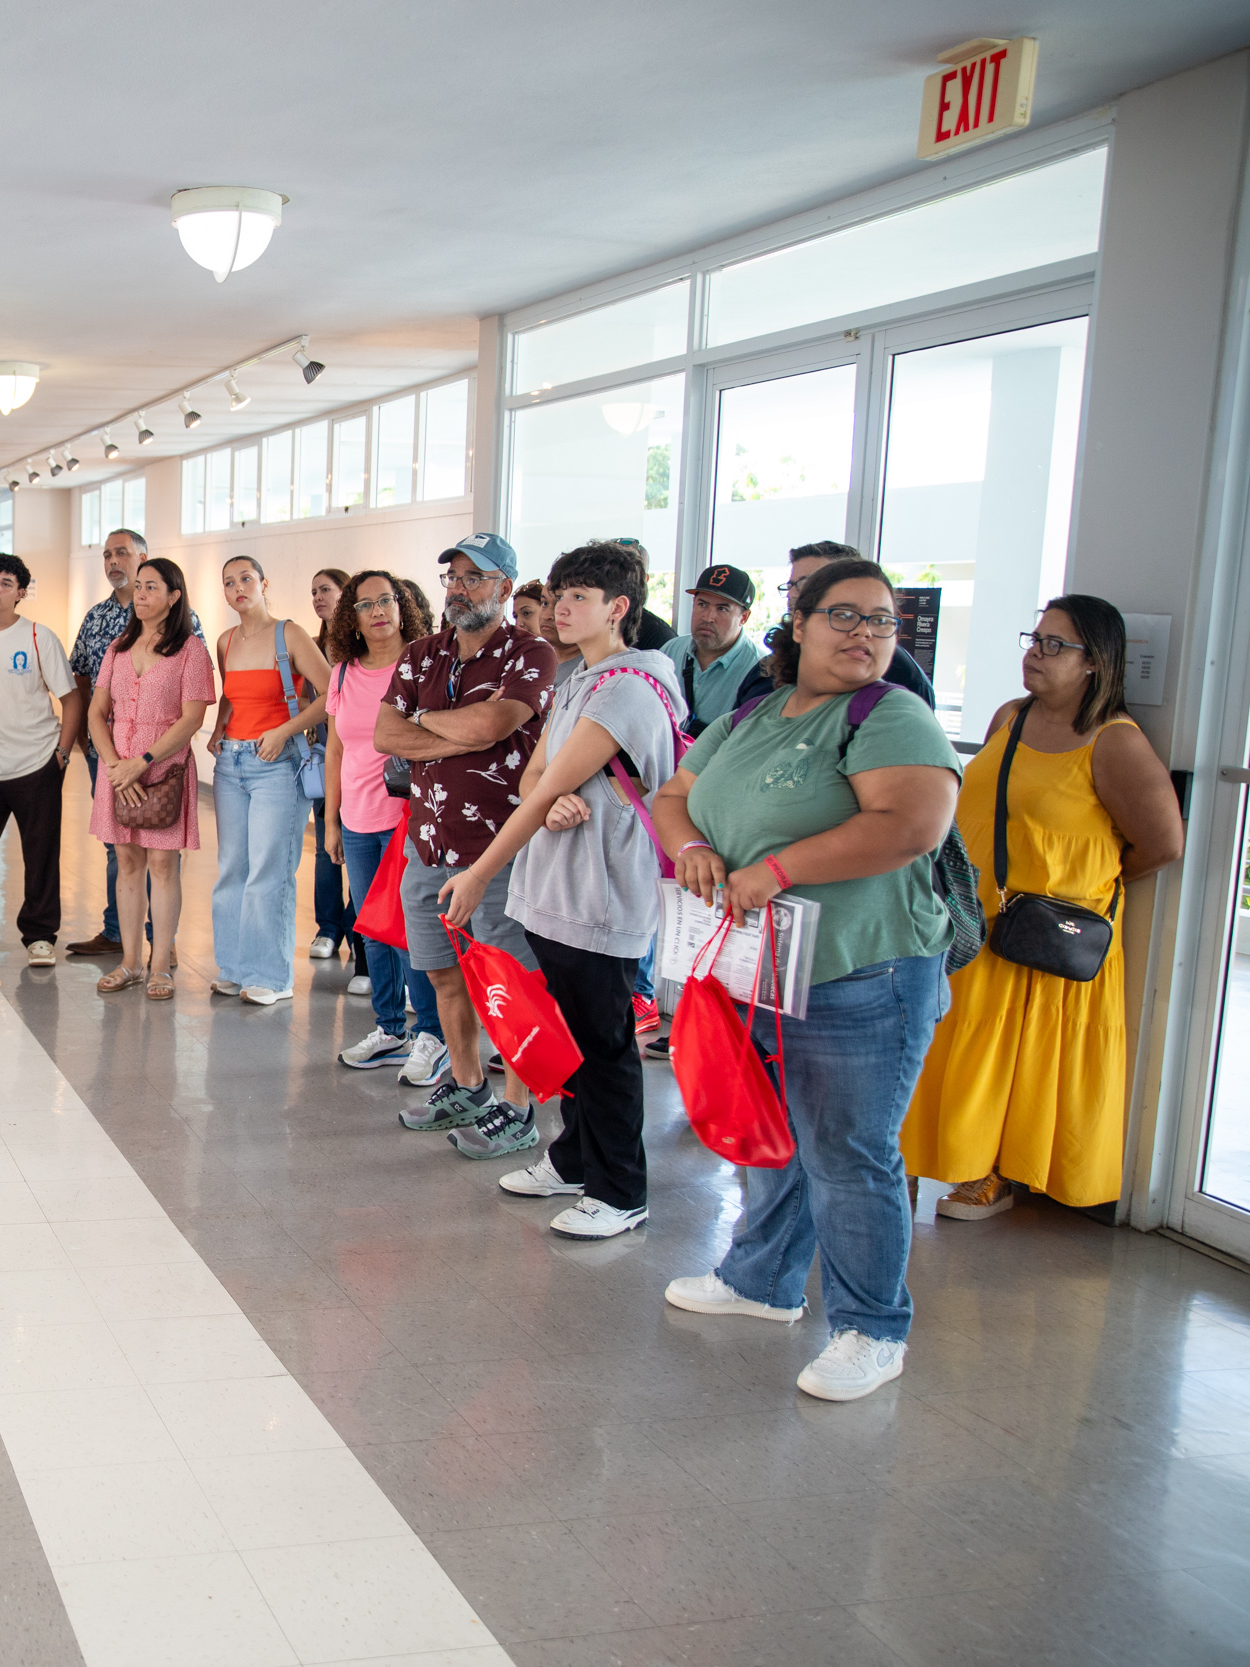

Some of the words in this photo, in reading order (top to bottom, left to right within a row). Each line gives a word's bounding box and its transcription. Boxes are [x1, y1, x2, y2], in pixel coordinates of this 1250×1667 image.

[934, 48, 1007, 144] EXIT
[675, 886, 683, 916] SERVICIOS
[675, 926, 682, 937] UN
[676, 916, 683, 926] EN
[672, 937, 680, 956] CLICK
[775, 932, 784, 957] Sistema
